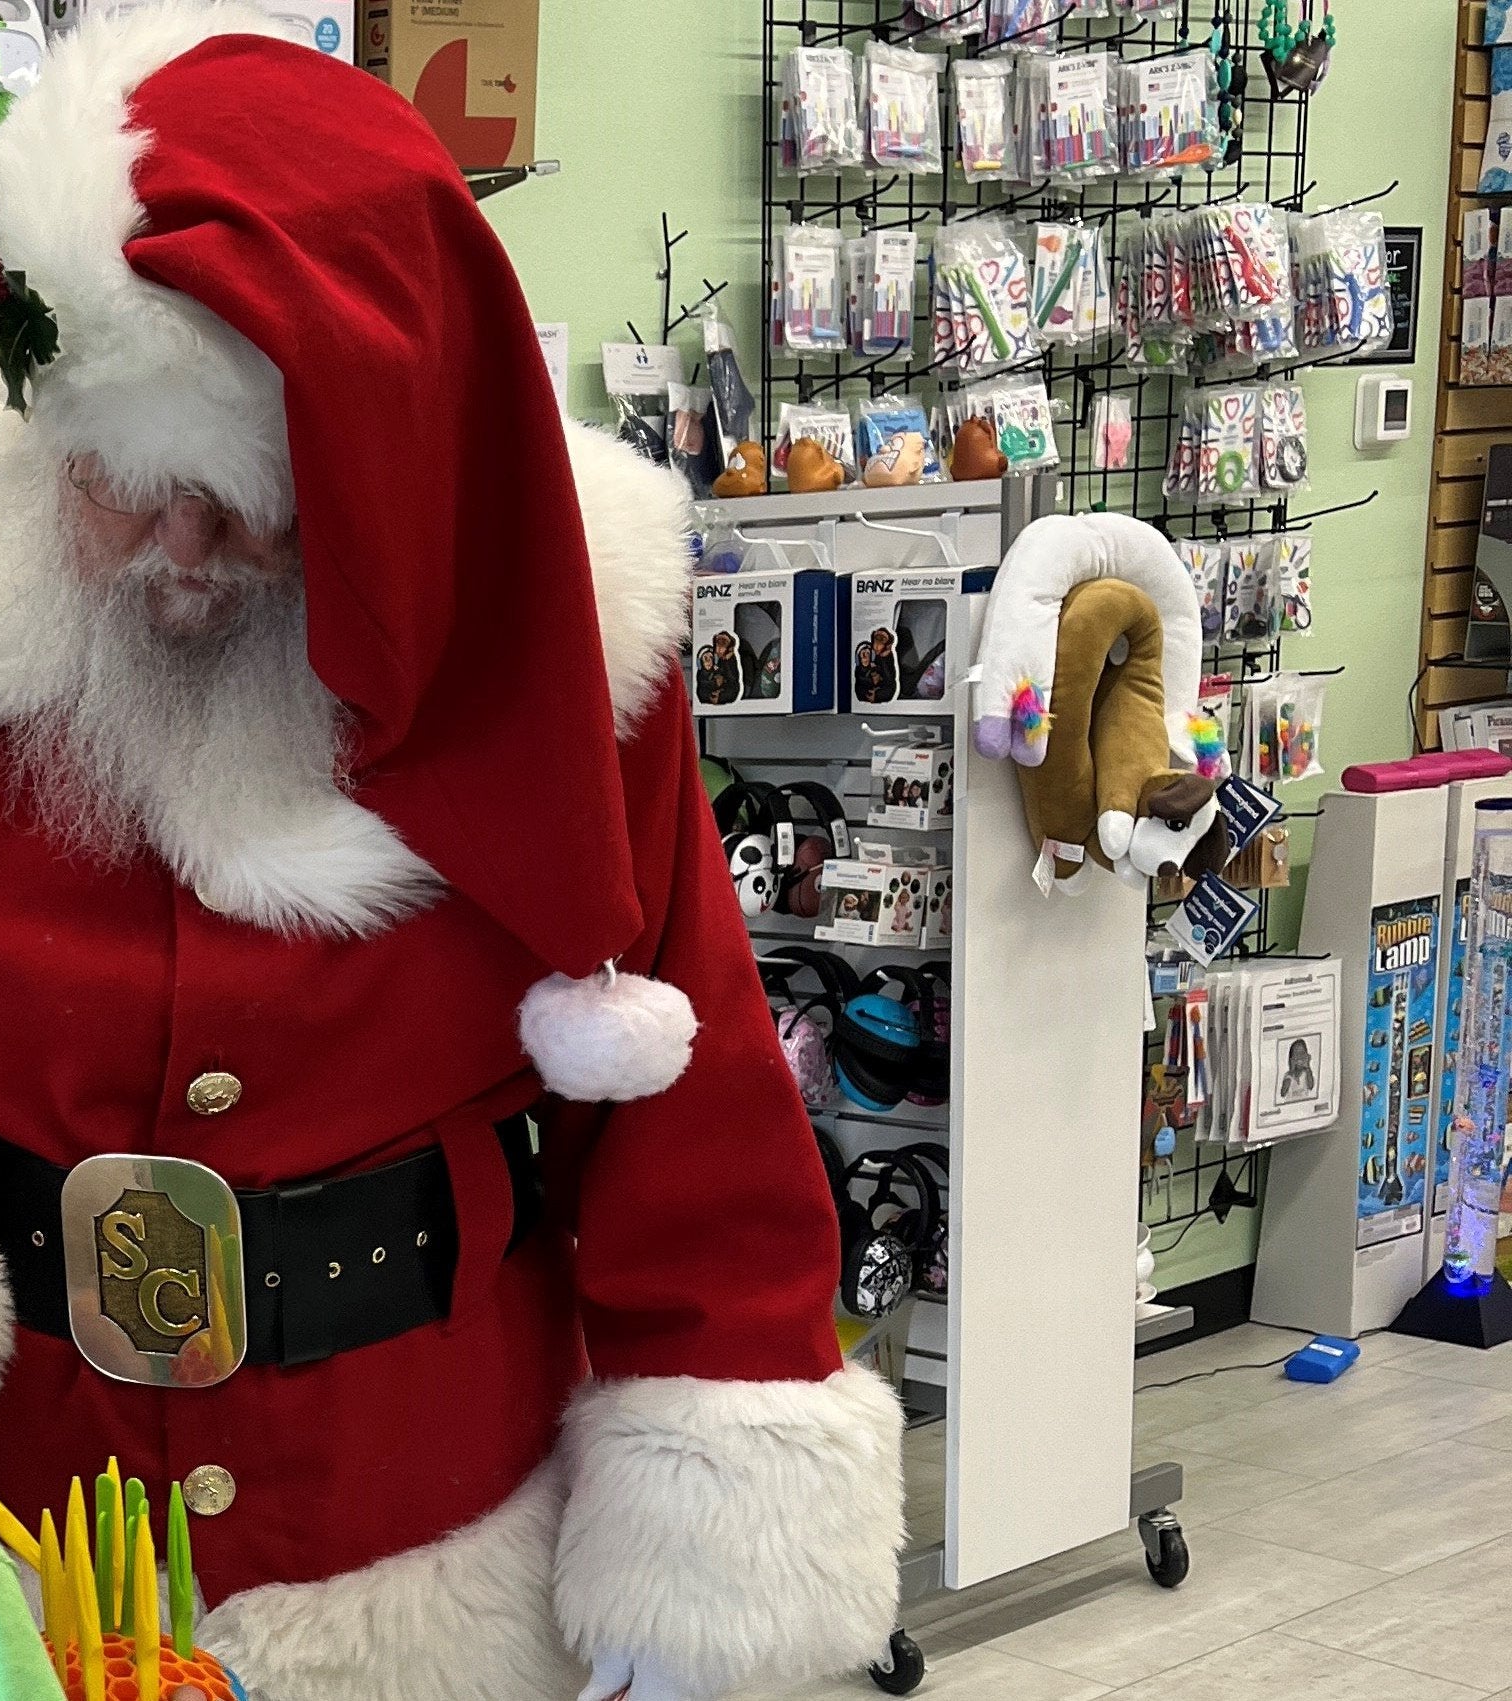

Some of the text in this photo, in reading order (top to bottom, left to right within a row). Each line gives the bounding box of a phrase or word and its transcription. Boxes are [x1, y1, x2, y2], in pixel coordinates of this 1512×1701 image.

[696, 584, 732, 599] BANZ
[856, 579, 894, 594] BANZ
[901, 578, 919, 586] Hear
[932, 577, 956, 586] blare
[1377, 917, 1432, 946] Bubble
[1375, 935, 1431, 973] Lamp
